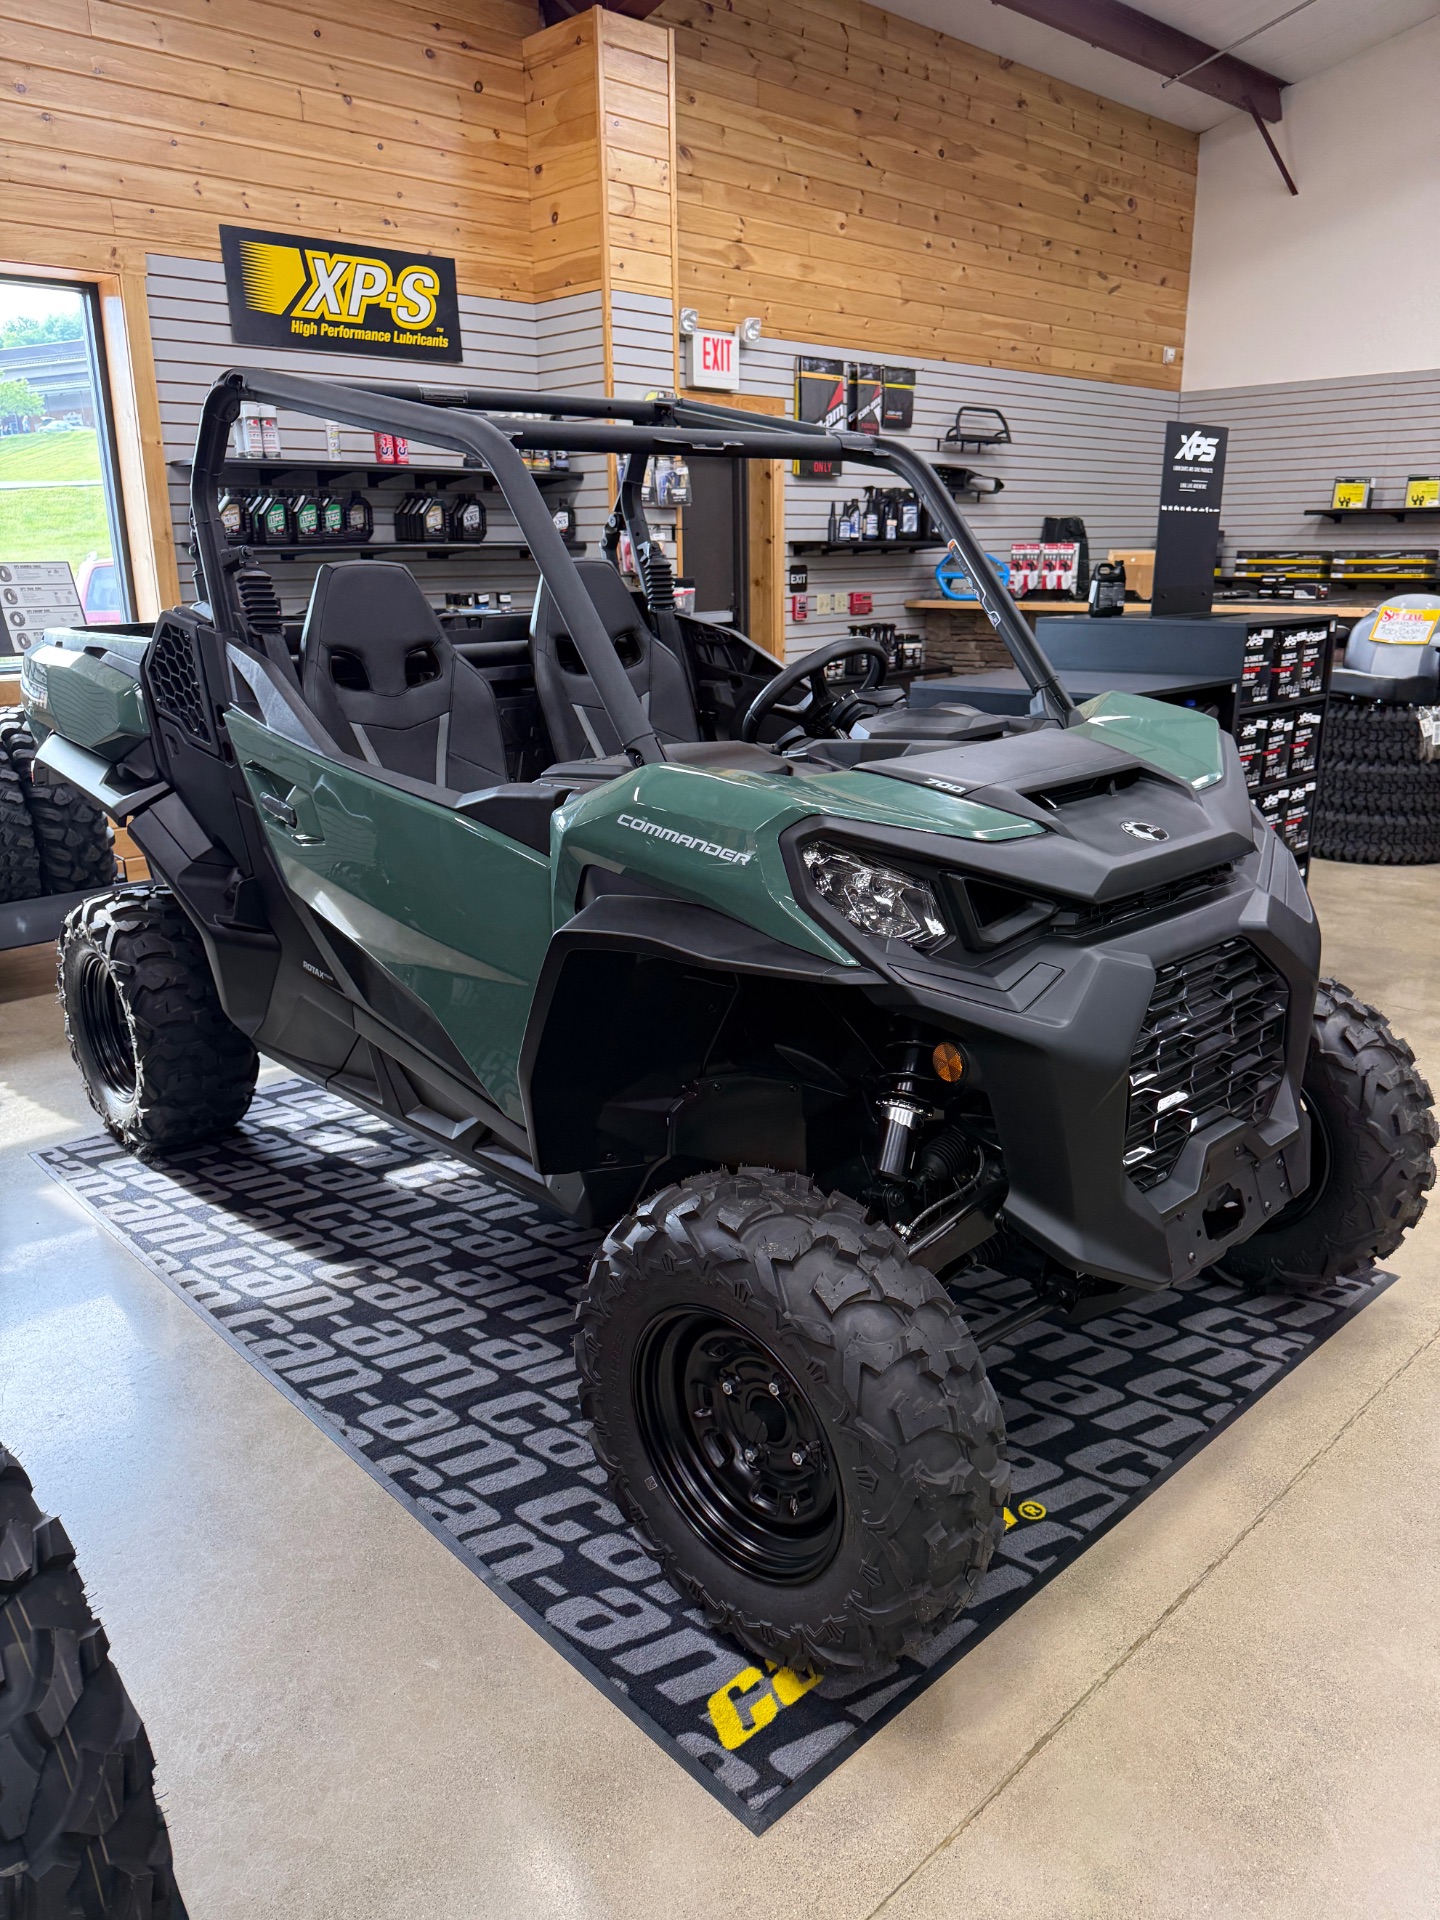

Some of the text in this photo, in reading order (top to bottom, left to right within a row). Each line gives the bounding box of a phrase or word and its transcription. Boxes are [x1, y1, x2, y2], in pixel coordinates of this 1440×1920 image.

[291, 320, 449, 348] High Performance Lubricants
[703, 336, 733, 373] EXIT
[1174, 430, 1220, 462] XPS
[813, 461, 833, 473] ONLY
[790, 573, 807, 585] EXIT
[924, 778, 966, 793] 700
[617, 814, 752, 866] COMMANDER
[303, 960, 325, 980] ROTAX
